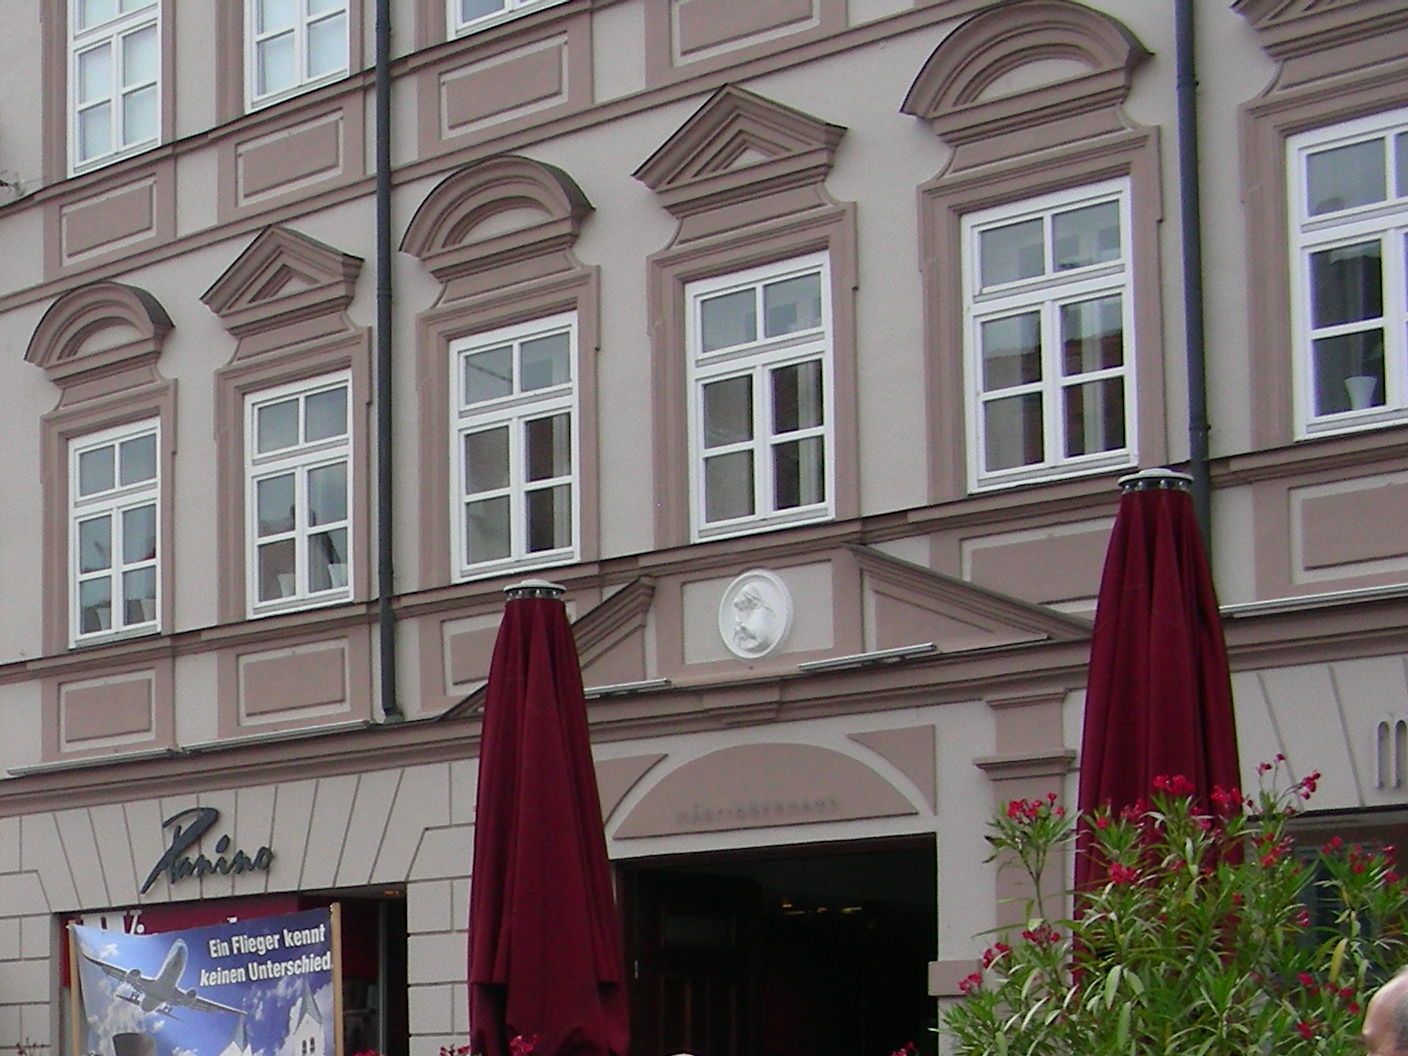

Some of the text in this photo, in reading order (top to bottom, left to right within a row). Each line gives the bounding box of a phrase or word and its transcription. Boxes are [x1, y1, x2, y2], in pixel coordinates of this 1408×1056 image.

[208, 923, 326, 958] Ein Flieger kennt
[200, 966, 246, 987] keinen
